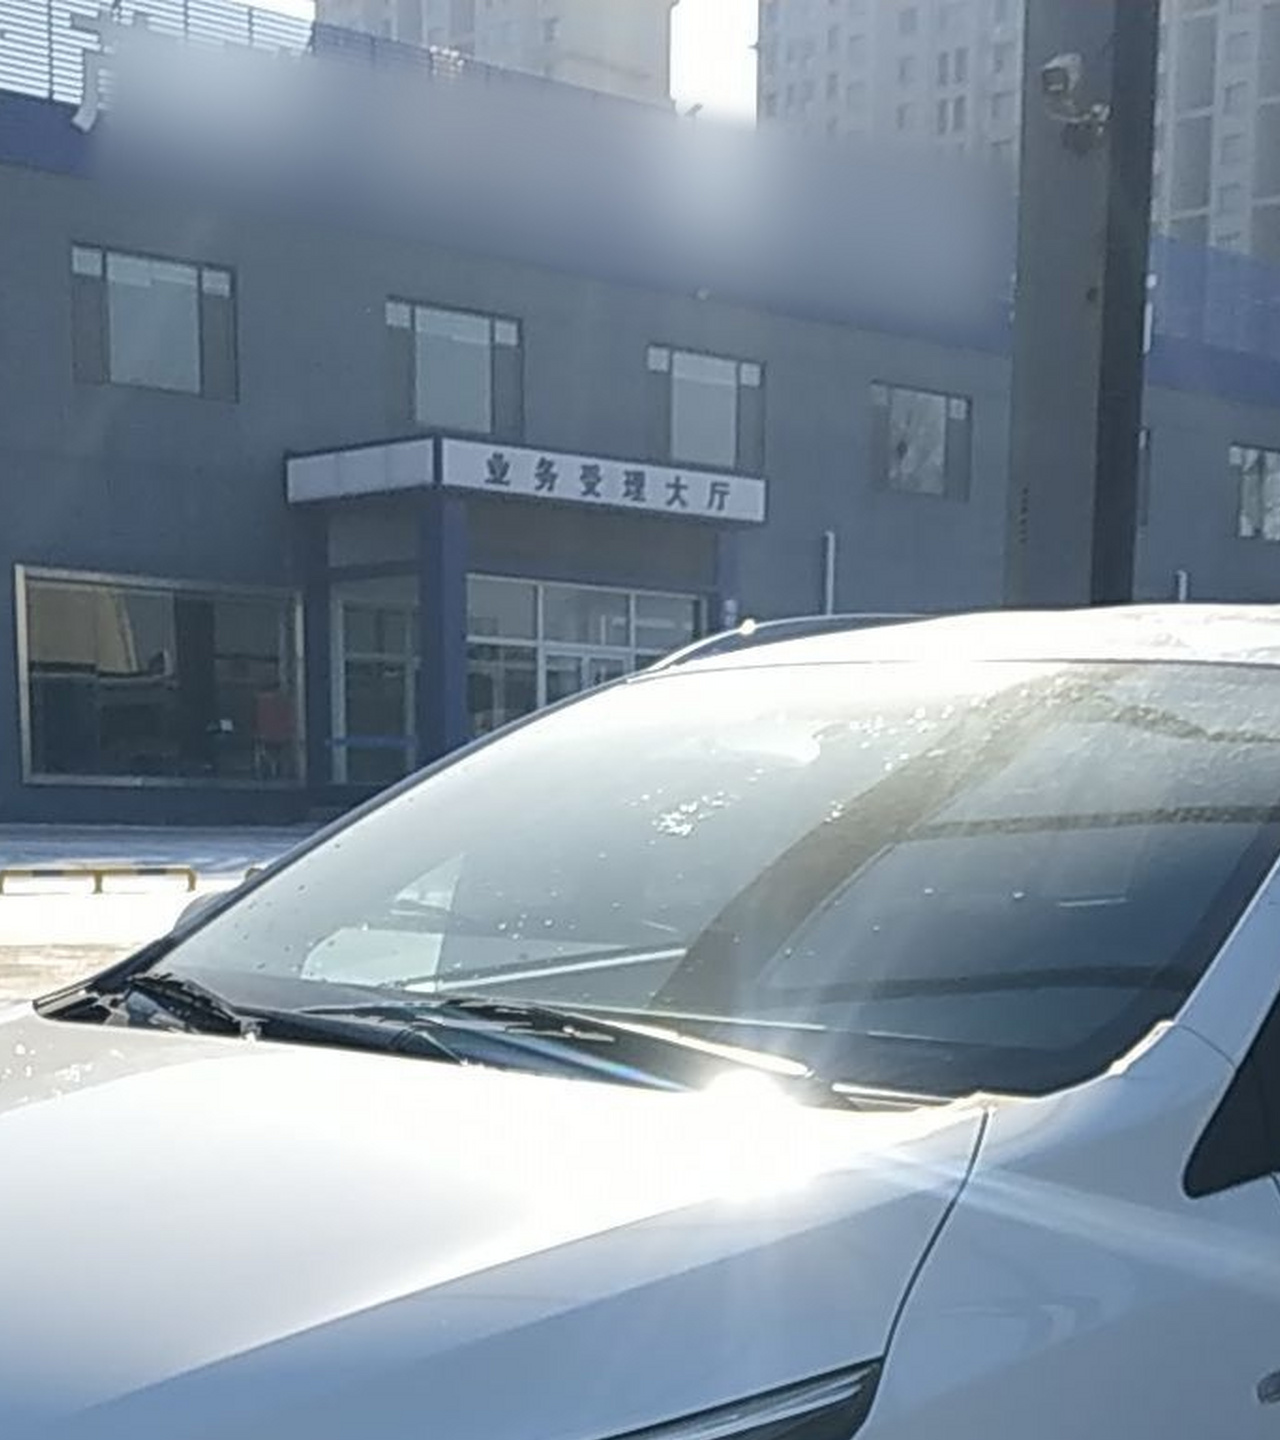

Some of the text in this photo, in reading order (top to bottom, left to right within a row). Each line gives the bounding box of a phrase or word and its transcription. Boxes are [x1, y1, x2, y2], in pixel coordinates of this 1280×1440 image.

[484, 452, 731, 511] 业务受理大厅
